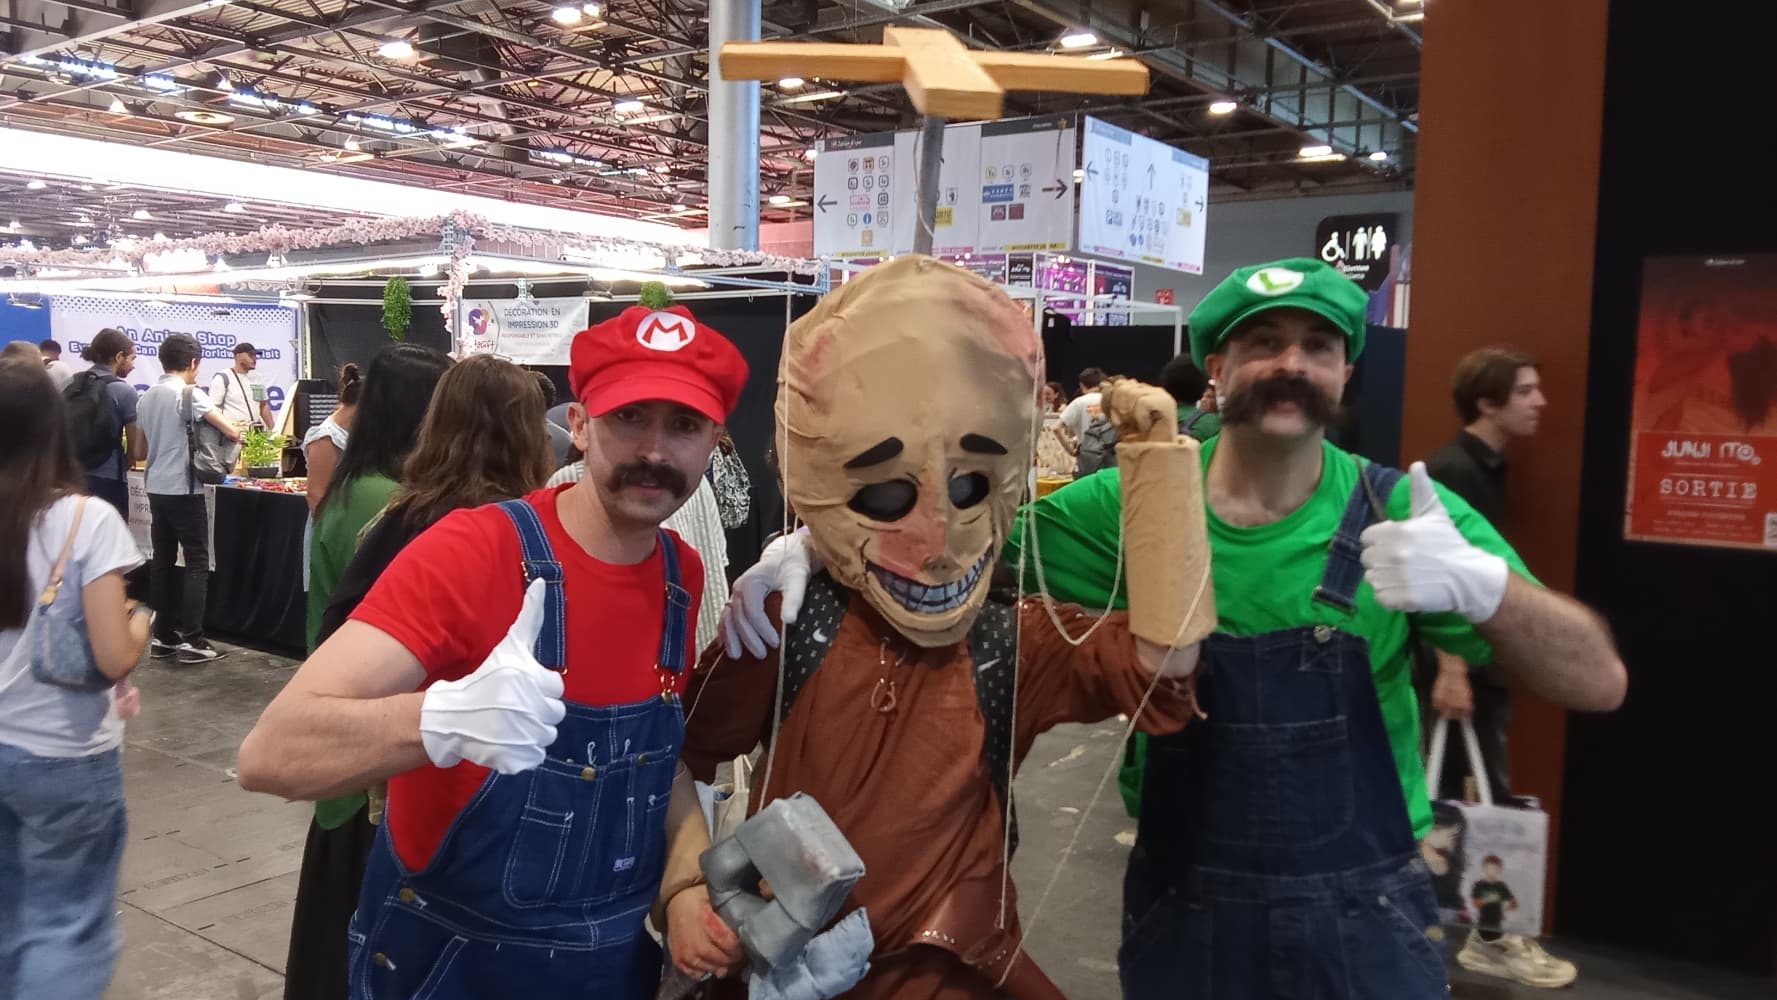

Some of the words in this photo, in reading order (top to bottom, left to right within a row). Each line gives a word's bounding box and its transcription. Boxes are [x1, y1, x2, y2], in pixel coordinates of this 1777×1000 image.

[1259, 272, 1294, 292] L
[551, 307, 560, 316] EN
[508, 320, 548, 329] IMPRESSION
[549, 320, 558, 329] 3D
[642, 317, 688, 344] M
[141, 328, 192, 342] Ani
[196, 331, 236, 347] Shop
[1662, 440, 1711, 458] JUNJI
[1660, 479, 1757, 499] SORTIE
